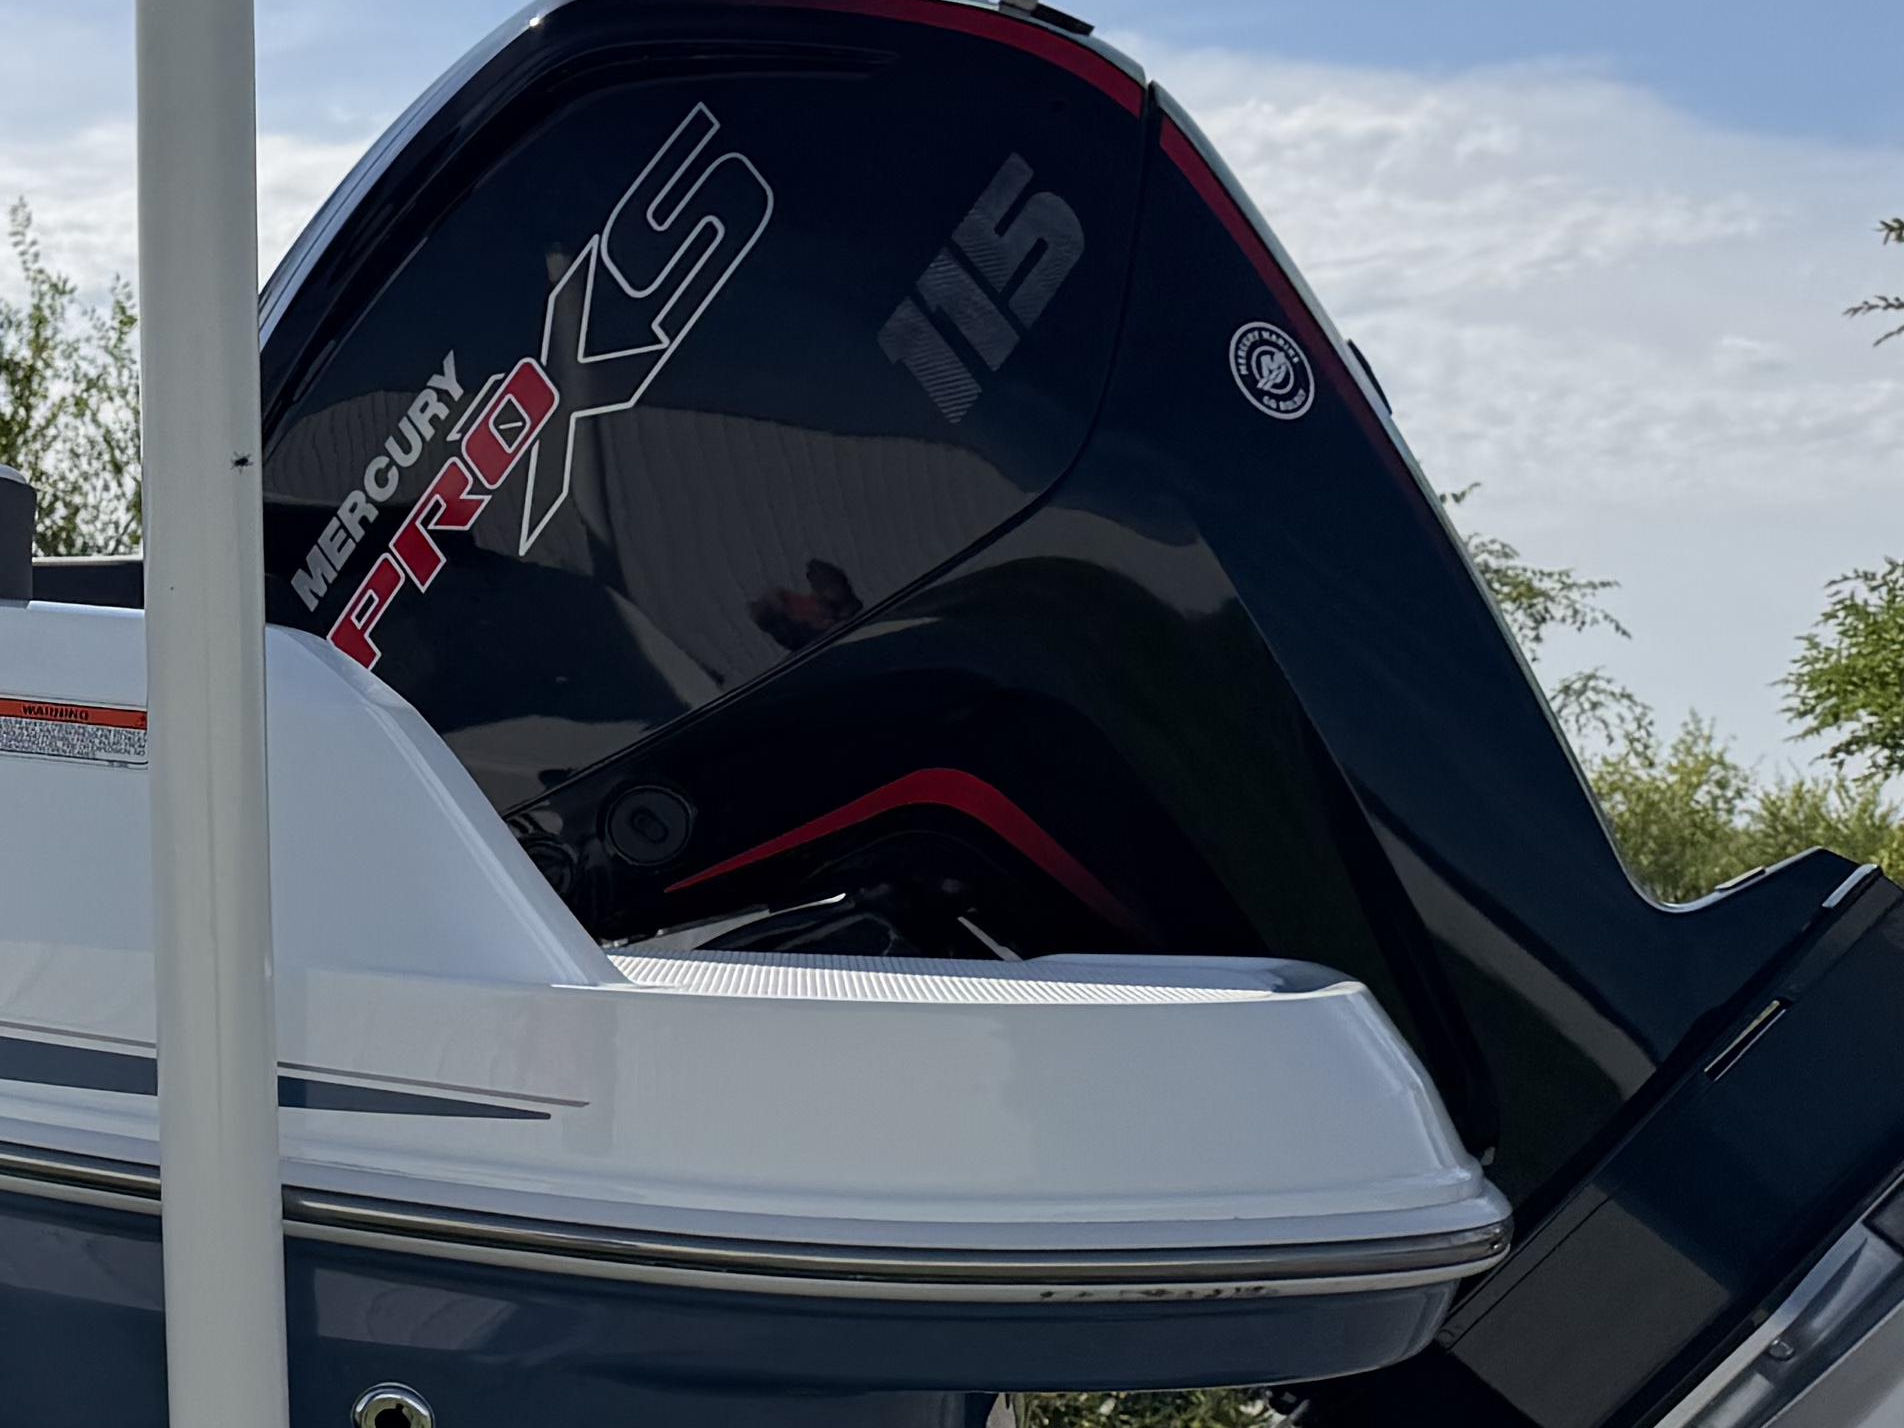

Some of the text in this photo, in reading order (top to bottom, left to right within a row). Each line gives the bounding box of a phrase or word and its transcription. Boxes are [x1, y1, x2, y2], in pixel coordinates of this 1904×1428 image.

[327, 101, 774, 671] PRO XS
[877, 152, 1085, 423] 115
[292, 349, 465, 612] MERCURY
[21, 704, 90, 722] WARNING
